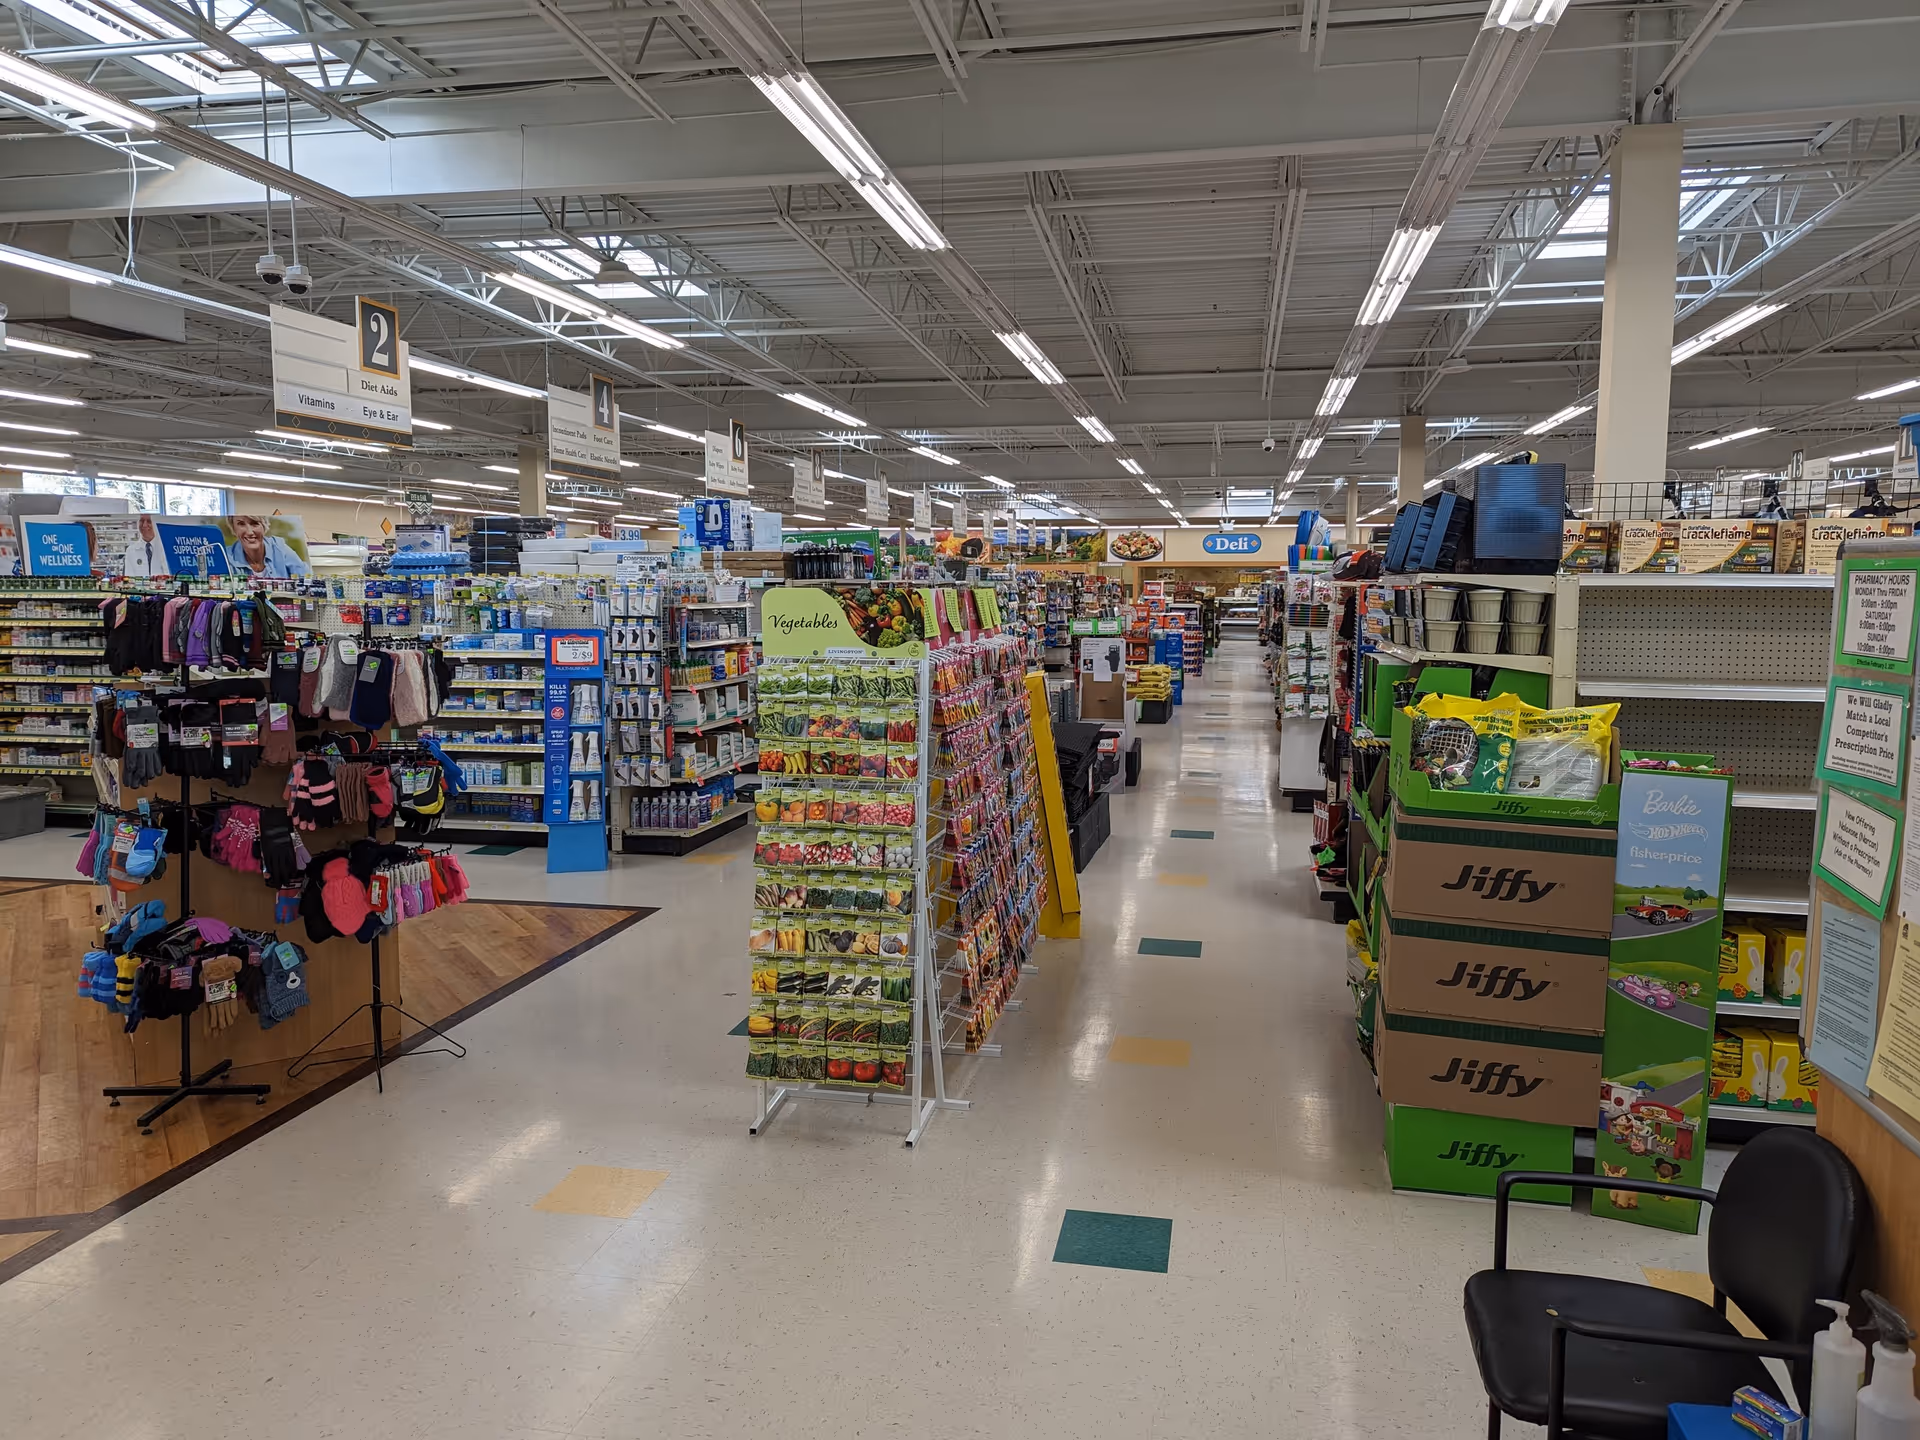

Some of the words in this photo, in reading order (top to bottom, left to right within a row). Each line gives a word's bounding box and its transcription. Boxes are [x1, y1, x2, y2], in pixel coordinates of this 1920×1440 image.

[369, 311, 389, 367] 2
[360, 379, 378, 392] Diet
[378, 382, 398, 397] Aids
[297, 393, 336, 411] Vitamins
[598, 385, 610, 425] 4
[362, 406, 377, 420] Eye
[378, 409, 385, 419] &
[385, 411, 400, 423] Ear
[576, 430, 587, 440] Pads
[594, 434, 604, 443] Foot
[604, 436, 614, 446] Care
[734, 426, 742, 458] 6
[578, 451, 587, 460] Care
[815, 453, 821, 479] 8
[1792, 450, 1804, 479] 13
[42, 534, 58, 545] ONE
[174, 536, 202, 546] VITAMIN
[620, 529, 640, 540] 3.99
[1624, 528, 1674, 539] Crackleflame
[1681, 528, 1751, 540] Crackleflame
[1812, 528, 1886, 541] Crackleflame
[58, 545, 74, 554] ONE
[1215, 538, 1248, 550] Deli
[40, 555, 82, 566] WELLNESS
[179, 556, 214, 567] HEAH
[1854, 574, 1888, 584] PHARMACY
[1888, 575, 1910, 586] HOURS
[1854, 587, 1876, 596] MONDAY
[1877, 588, 1888, 596] Thru
[1888, 588, 1908, 597] FRIDAY
[768, 612, 838, 634] Vegetables
[1865, 611, 1892, 620] SATURDAY
[1867, 633, 1888, 642] SUNDAY
[572, 651, 593, 660] 2/$9
[1848, 695, 1858, 705] We
[1860, 696, 1872, 708] Will
[1873, 698, 1893, 714] Gladly
[1846, 710, 1868, 723] Match
[1874, 714, 1891, 727] Local
[1846, 724, 1888, 742] Competitor's
[1835, 738, 1878, 755] Prescription
[1879, 746, 1894, 760] Price
[1491, 800, 1530, 815] Jiffy
[1642, 790, 1702, 816] Barbie
[1845, 809, 1855, 822] Now
[1855, 816, 1875, 836] Offering
[1648, 826, 1671, 840] HOT
[1838, 820, 1858, 839] Naloxone
[1858, 832, 1879, 852] (Narcan)
[1630, 846, 1702, 864] fisher-price
[1833, 831, 1849, 848] Without
[1854, 844, 1880, 867] Prescription
[1855, 858, 1873, 878] Pharmacy)
[1440, 865, 1558, 903] Jiffy
[1436, 962, 1552, 1002] Jiffy
[1428, 1058, 1544, 1098] Jiffy
[1437, 1140, 1519, 1169] Jiffy
